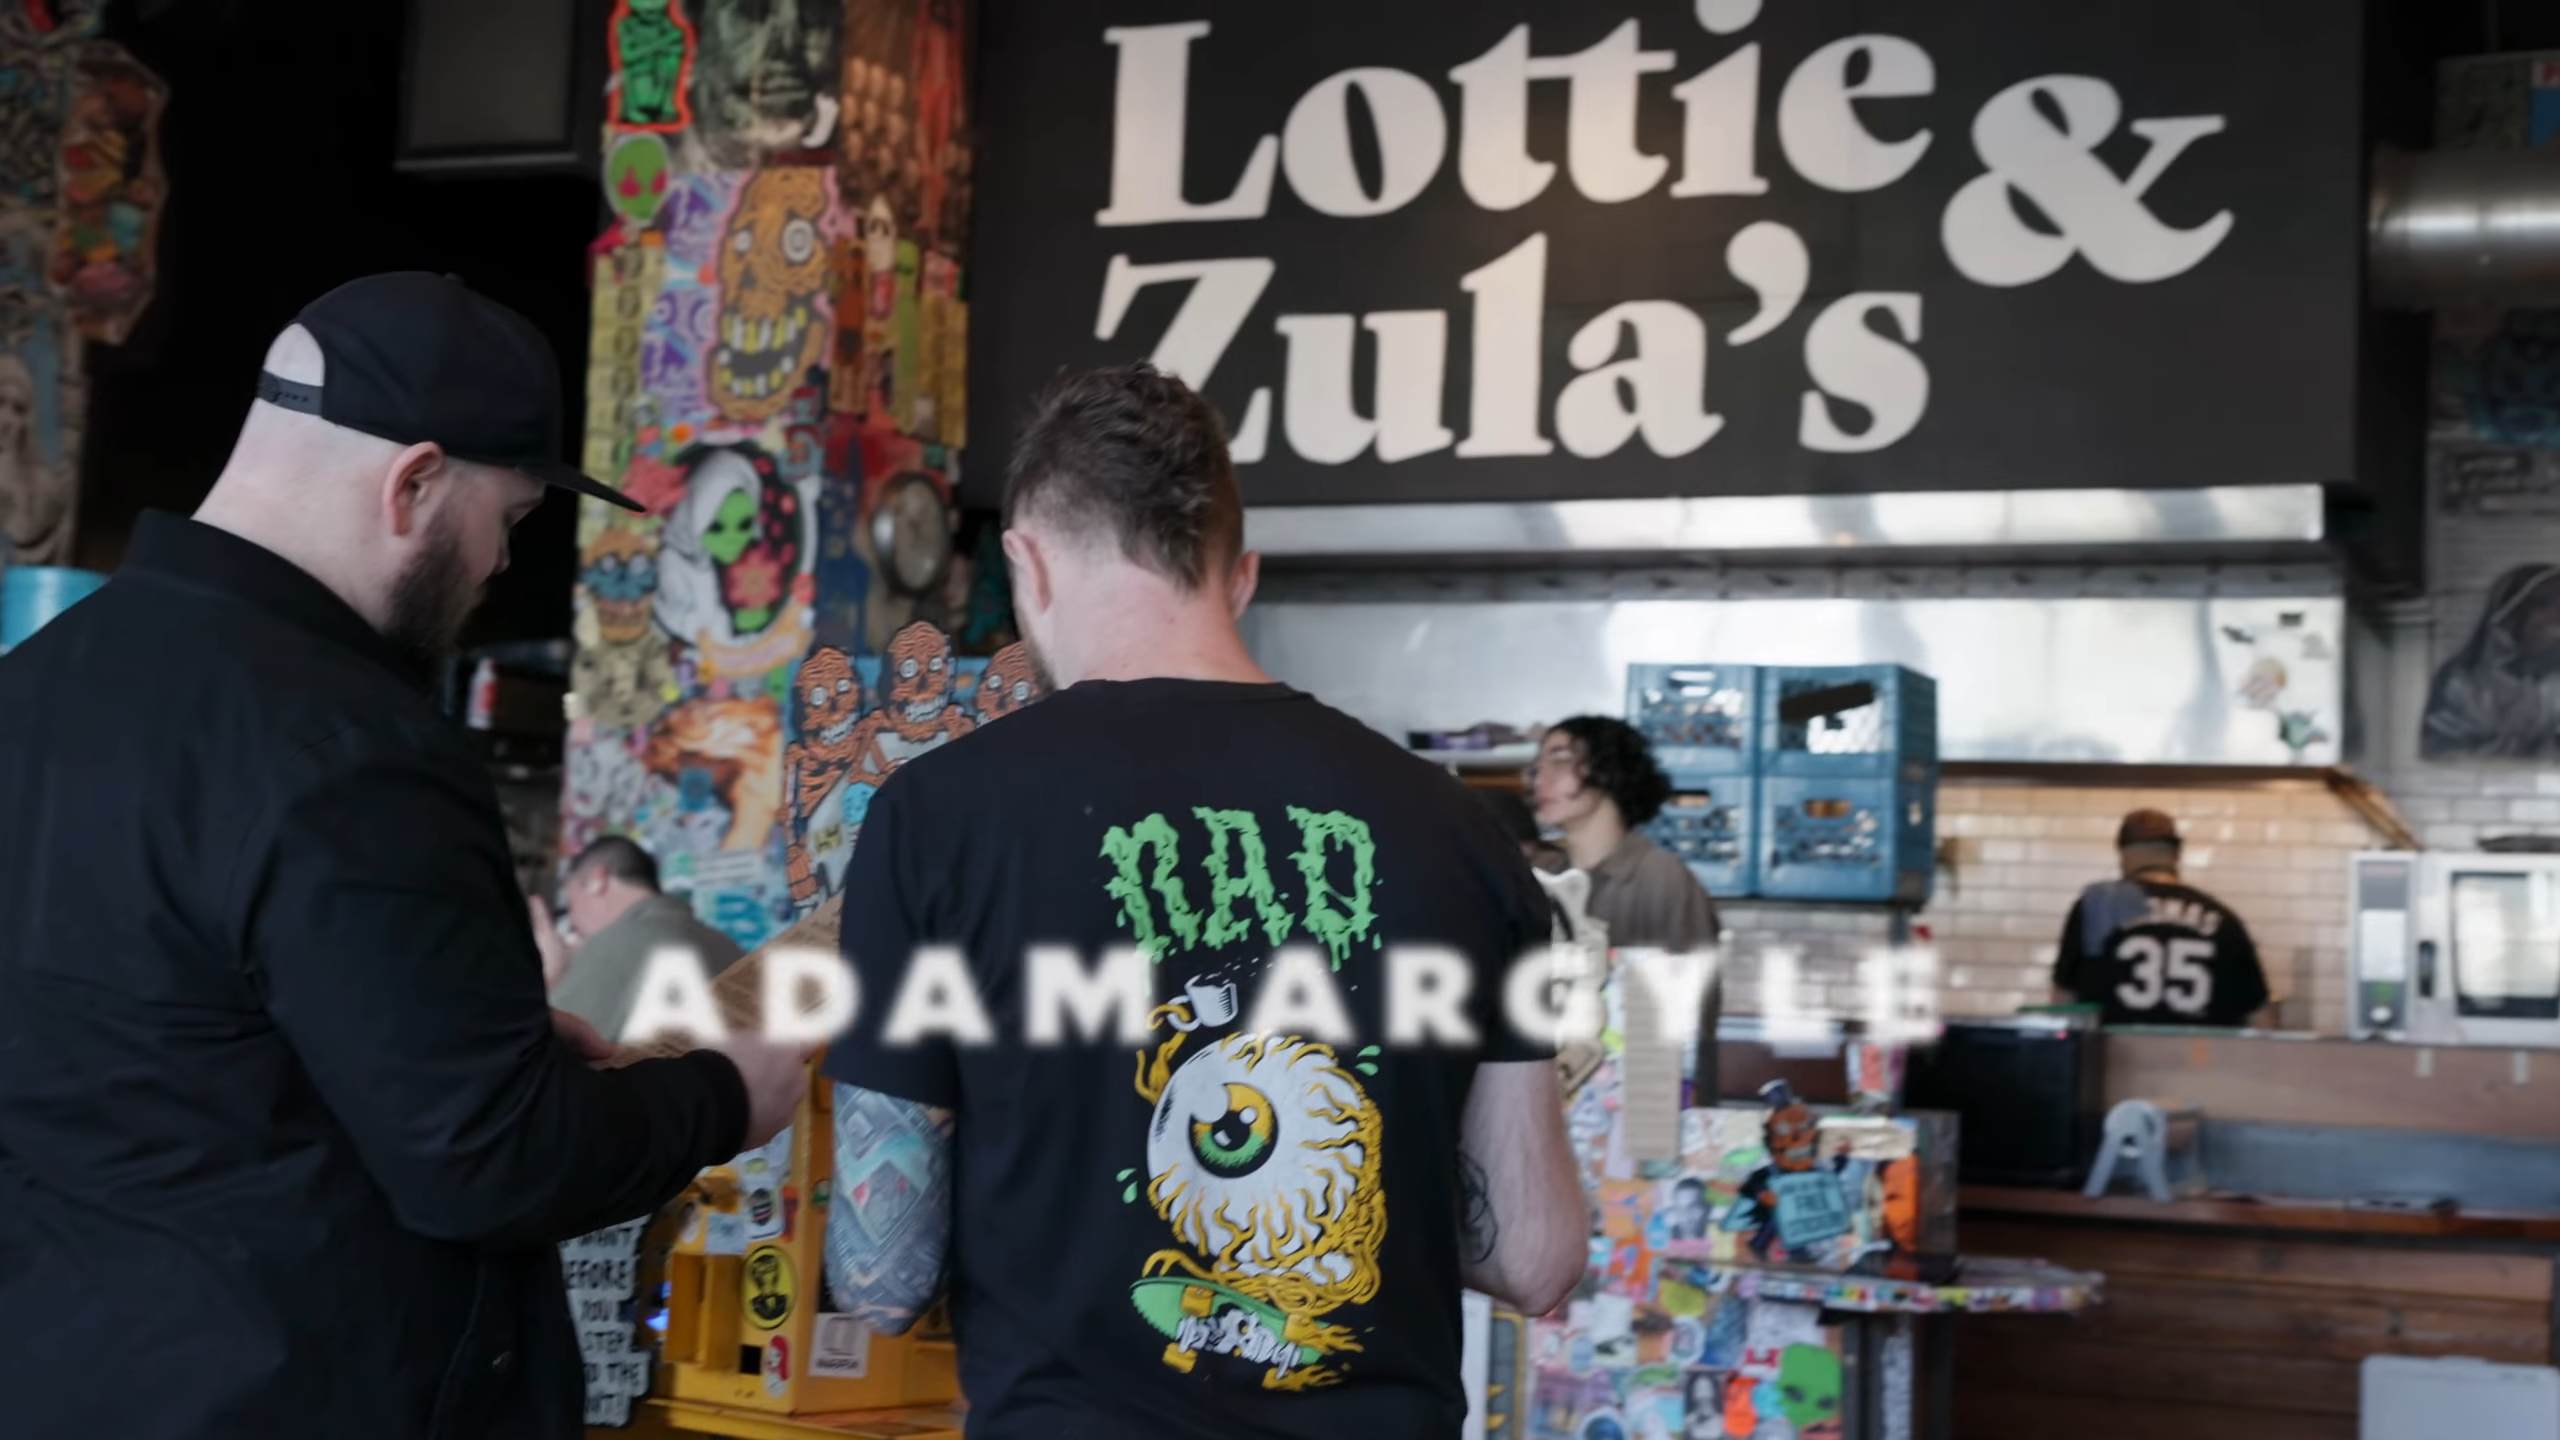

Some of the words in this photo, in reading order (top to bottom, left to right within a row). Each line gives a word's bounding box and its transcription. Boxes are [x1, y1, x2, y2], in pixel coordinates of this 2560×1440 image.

[1096, 0, 1935, 226] Lottie
[1942, 74, 2236, 288] &
[1099, 804, 1378, 972] RAD
[2115, 935, 2214, 1012] 35
